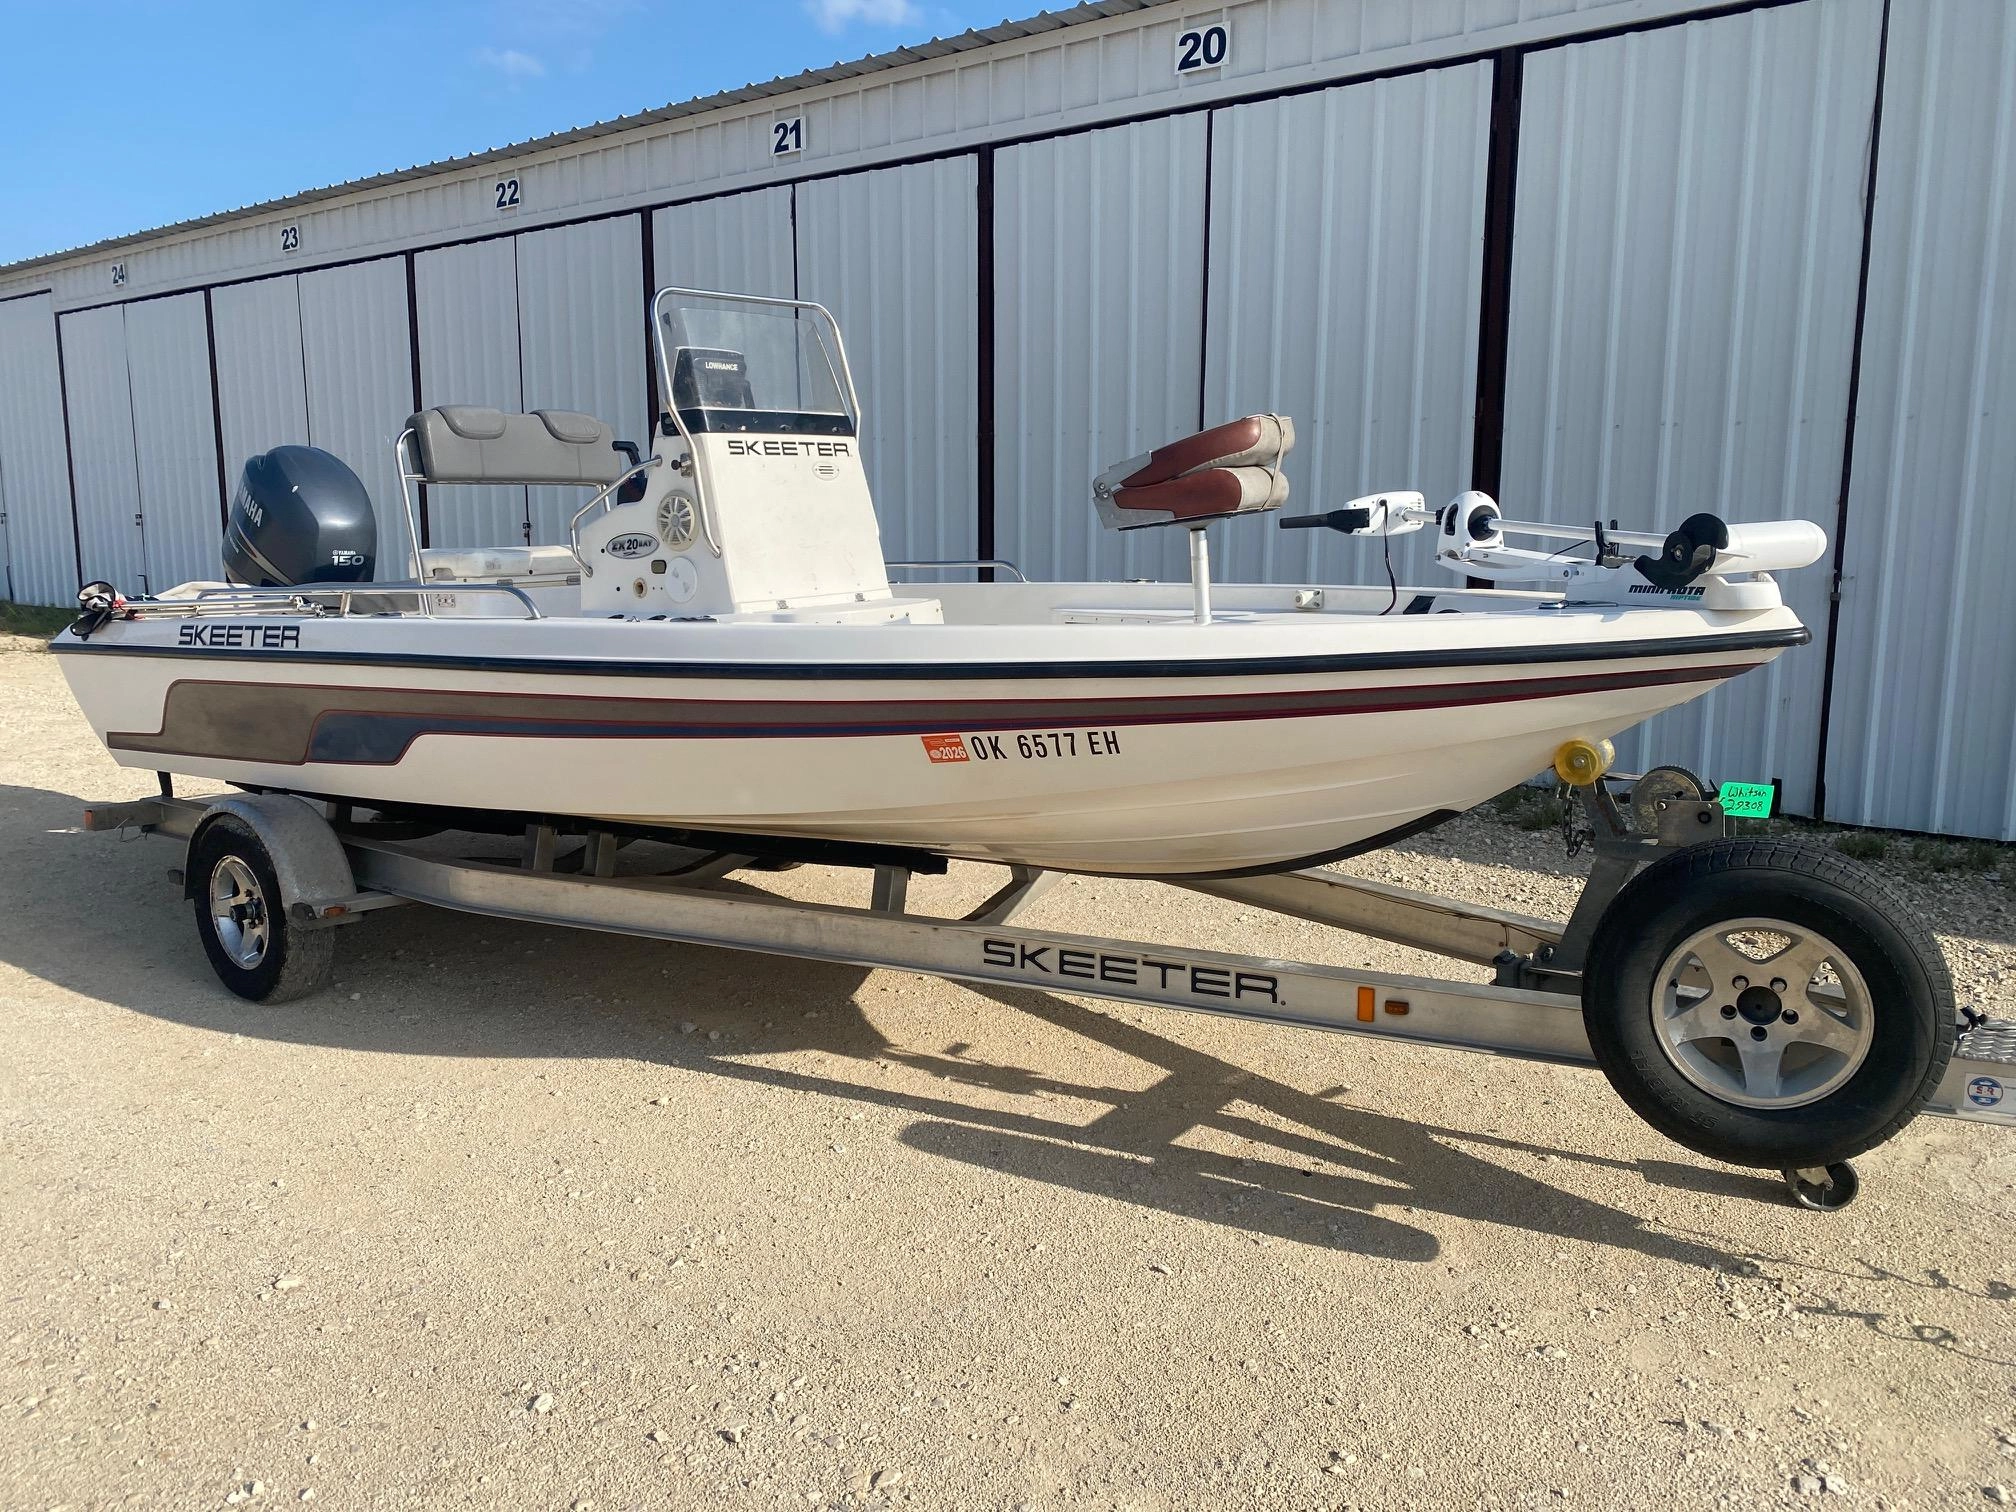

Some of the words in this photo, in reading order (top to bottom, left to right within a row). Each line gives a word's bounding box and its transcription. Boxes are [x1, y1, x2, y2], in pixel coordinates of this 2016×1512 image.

[1178, 26, 1227, 71] 20
[773, 119, 802, 153] 21
[495, 179, 519, 208] 22
[281, 226, 299, 250] 23
[111, 264, 125, 284] 24
[705, 361, 739, 371] LOWRANCE
[728, 440, 850, 456] SKEETER
[331, 555, 365, 566] 150
[178, 625, 300, 648] SKEETER
[939, 746, 967, 759] 2026
[971, 735, 1007, 760] OK
[1016, 733, 1077, 759] 6577
[1087, 730, 1121, 755] EH
[984, 939, 1278, 1004] SKEETER
